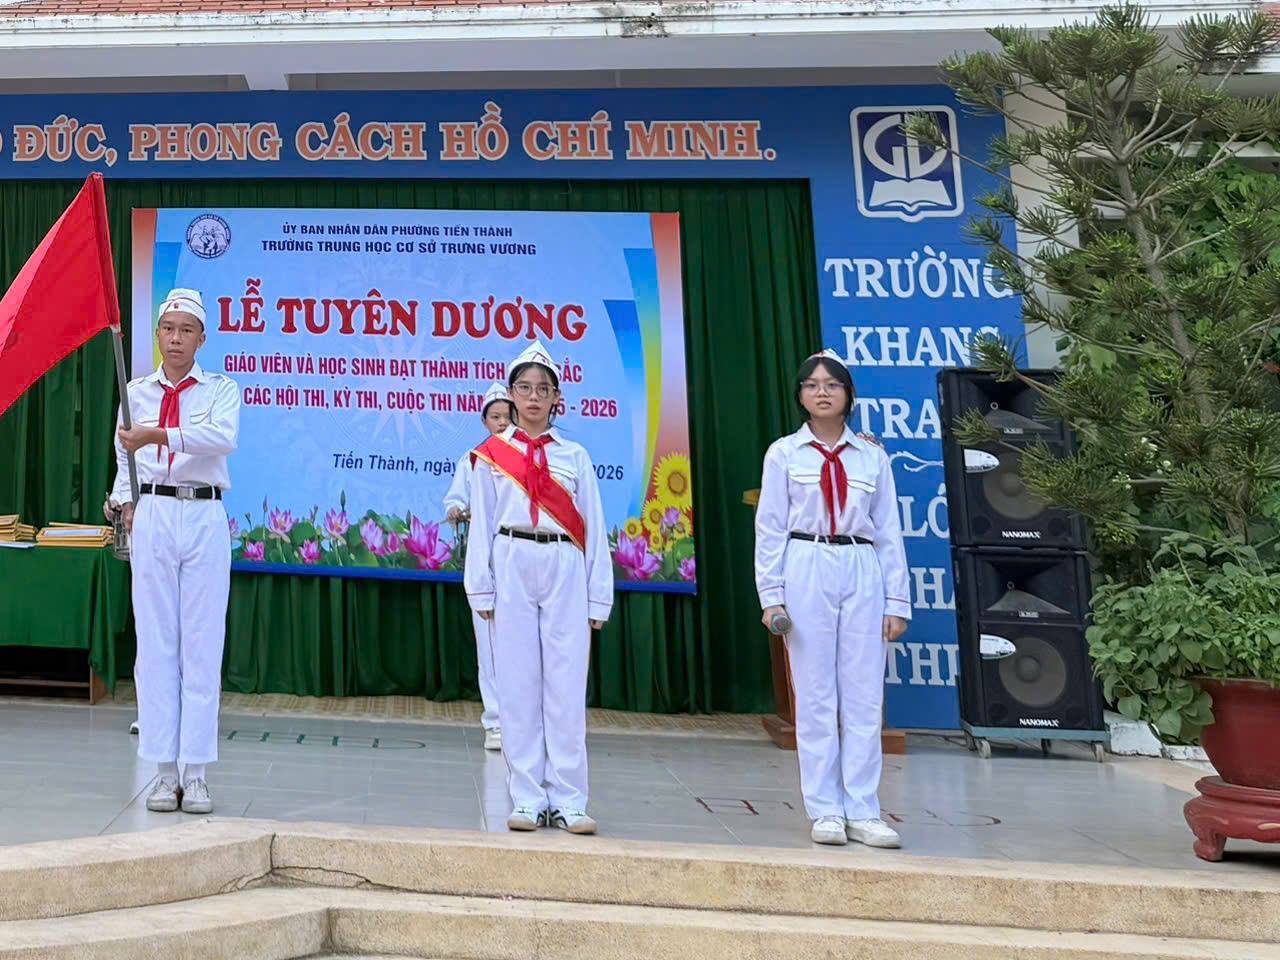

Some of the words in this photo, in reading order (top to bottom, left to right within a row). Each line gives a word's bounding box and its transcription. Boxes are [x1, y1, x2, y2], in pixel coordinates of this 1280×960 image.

[12, 114, 118, 166] ĐỨC,
[128, 121, 283, 162] PHONG
[295, 111, 427, 161] CÁCH
[439, 100, 509, 161] HỒ
[522, 109, 613, 161] CHÍ
[624, 120, 777, 161] MINH.
[300, 225, 325, 235] BAN
[328, 223, 360, 235] NHÂN
[364, 224, 388, 236] DÂN
[391, 224, 440, 236] PHƯỜNG
[472, 225, 513, 237] THÀNH
[261, 238, 314, 252] TRƯỜNG
[317, 241, 361, 252] TRUNG
[365, 241, 392, 255] HỌC
[396, 241, 415, 253] CƠ
[418, 239, 437, 253] SỞ
[440, 242, 486, 254] TRƯNG
[490, 242, 537, 255] VƯƠNG
[217, 278, 265, 334] LỄ
[276, 288, 419, 337] TUYÊN
[431, 296, 588, 342] DƯƠNG
[224, 351, 257, 373] GIÁO
[260, 352, 292, 374] VIÊN
[296, 353, 315, 375] VÀ
[319, 357, 347, 379] HỌC
[351, 358, 386, 377] SINH
[389, 359, 417, 381] ĐẠT
[420, 356, 469, 380] THÀNH
[472, 357, 505, 380] TÍCH
[243, 384, 271, 405] CÁC
[276, 385, 299, 410] HỘI
[303, 389, 330, 410] THI,
[334, 387, 352, 408] KỲ
[356, 391, 382, 411] THI,
[387, 388, 425, 415] CUỘC
[429, 393, 452, 412] THI
[581, 398, 618, 418] 2026
[854, 397, 941, 439] TRA
[333, 450, 363, 470] Tiến
[369, 454, 419, 474] Thành,
